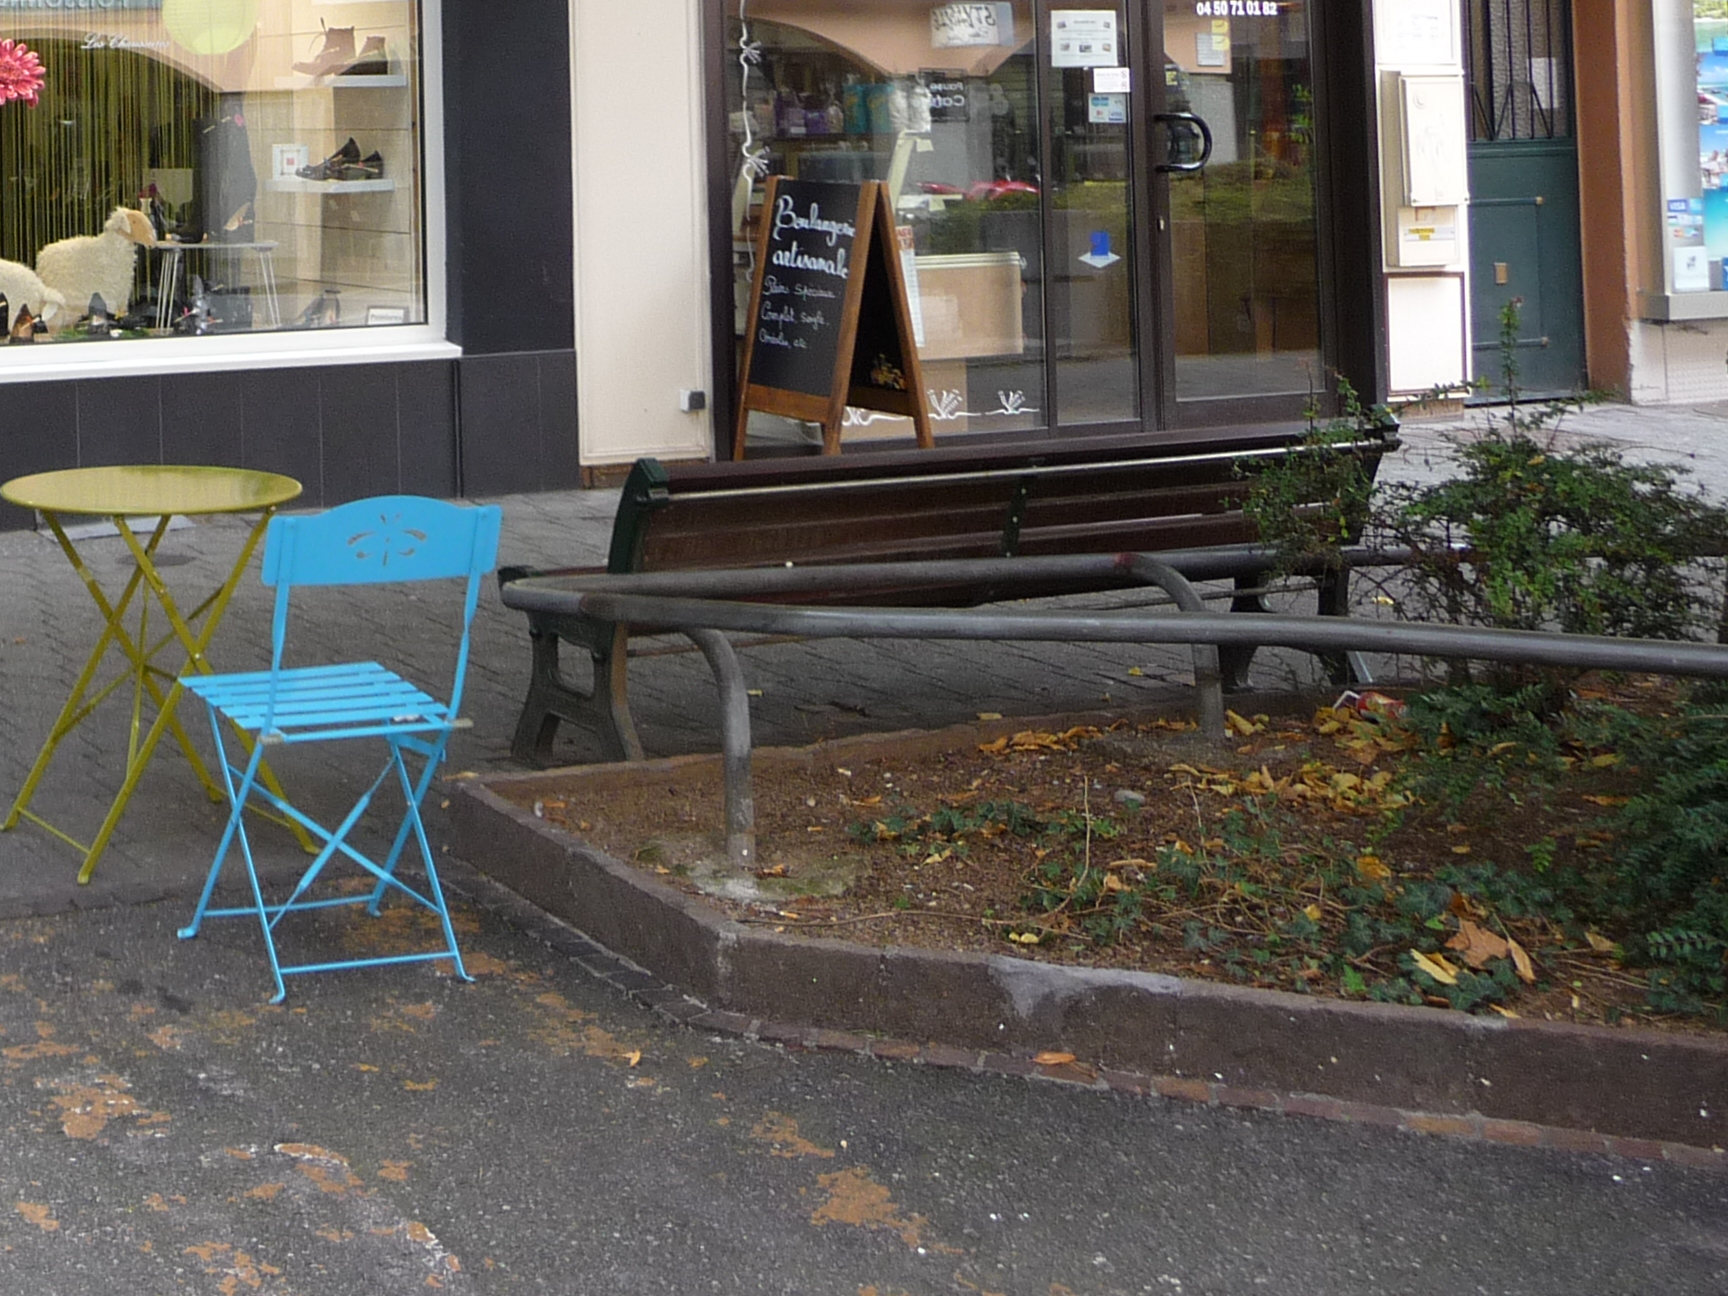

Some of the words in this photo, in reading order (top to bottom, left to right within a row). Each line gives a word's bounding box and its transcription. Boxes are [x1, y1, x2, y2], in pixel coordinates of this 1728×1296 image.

[1196, 1, 1212, 16] 04
[1213, 0, 1229, 16] 50
[1230, 0, 1245, 16] 71
[1246, 0, 1261, 16] 01
[1262, 0, 1278, 16] 82
[772, 194, 856, 247] Boulangerie
[772, 240, 849, 279] artisanale
